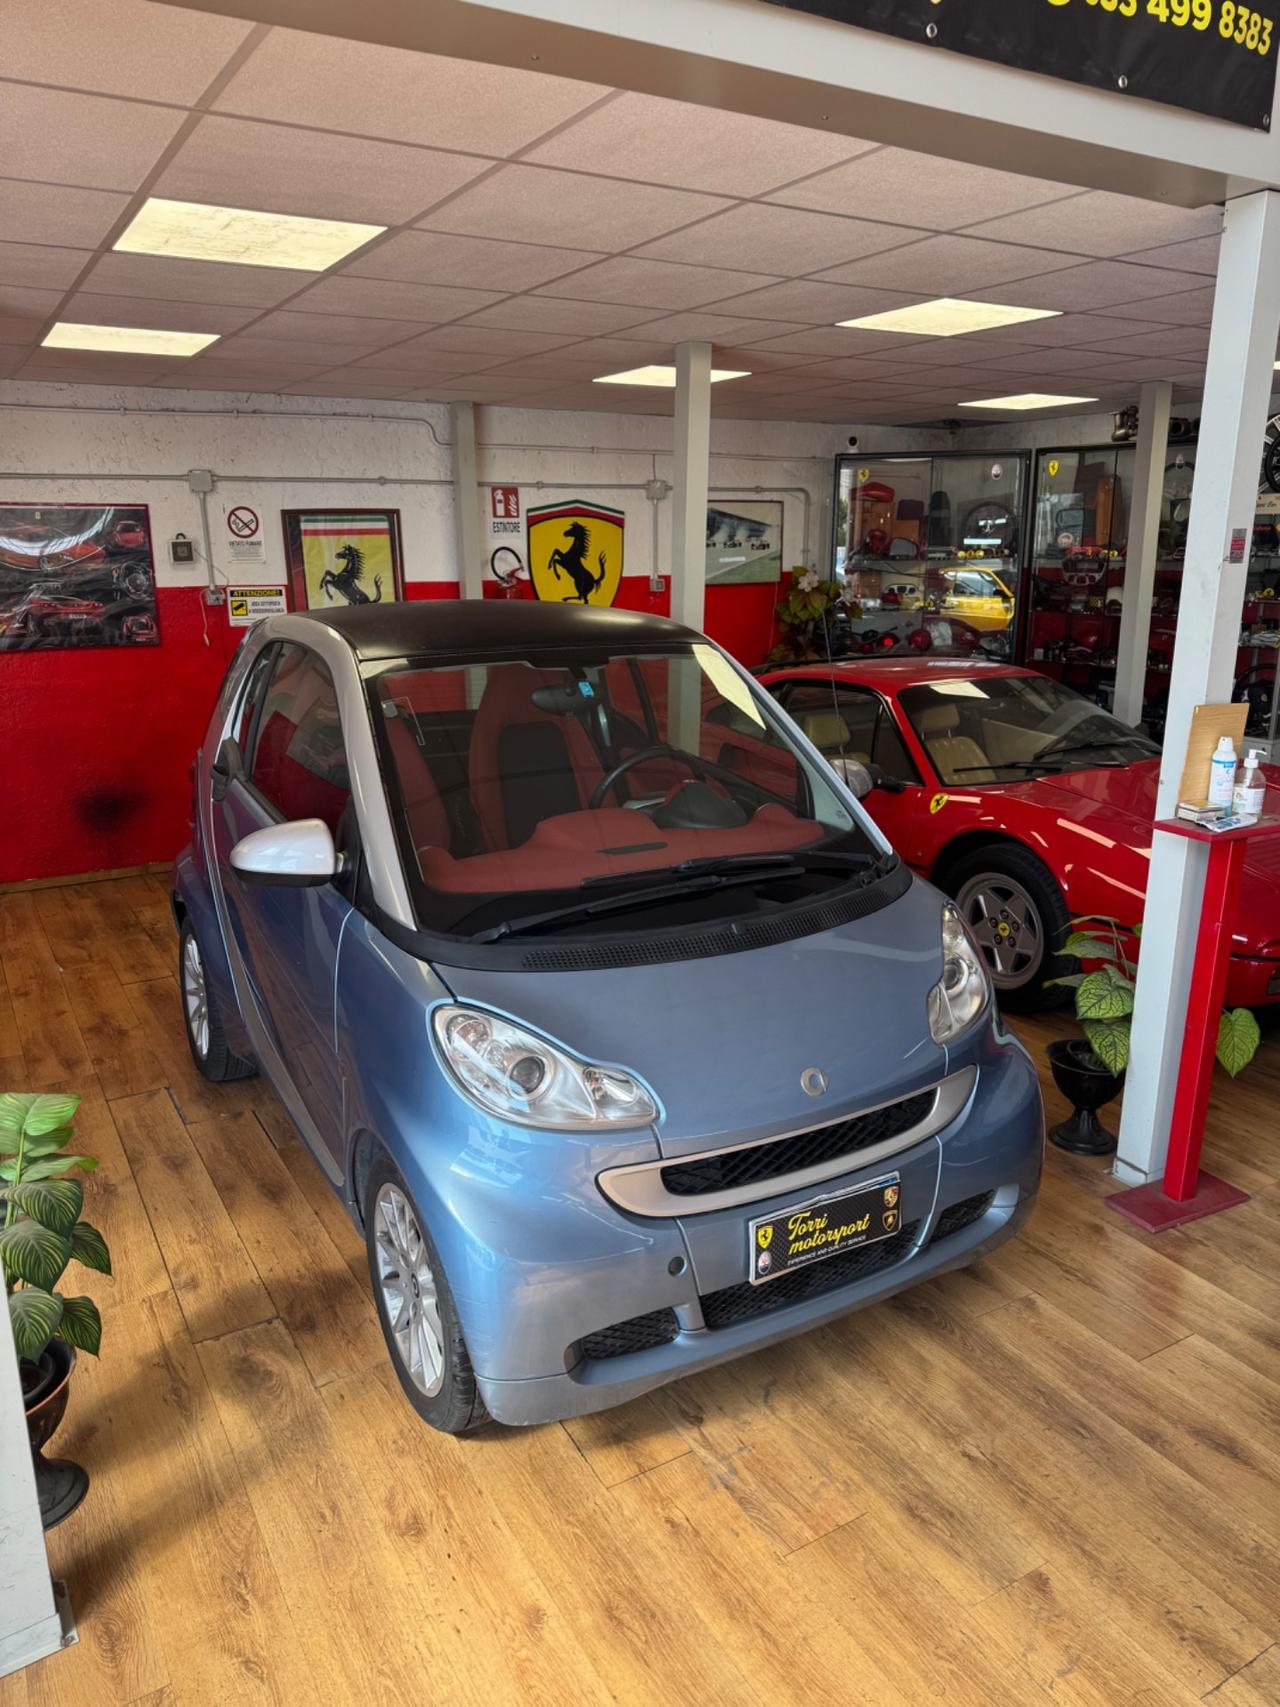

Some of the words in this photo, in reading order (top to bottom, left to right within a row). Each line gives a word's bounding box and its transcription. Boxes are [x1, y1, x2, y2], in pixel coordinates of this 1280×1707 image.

[1146, 0, 1212, 31] 499
[1218, 0, 1274, 56] 8383
[788, 1211, 829, 1241] Torri
[788, 1213, 870, 1255] motorsport
